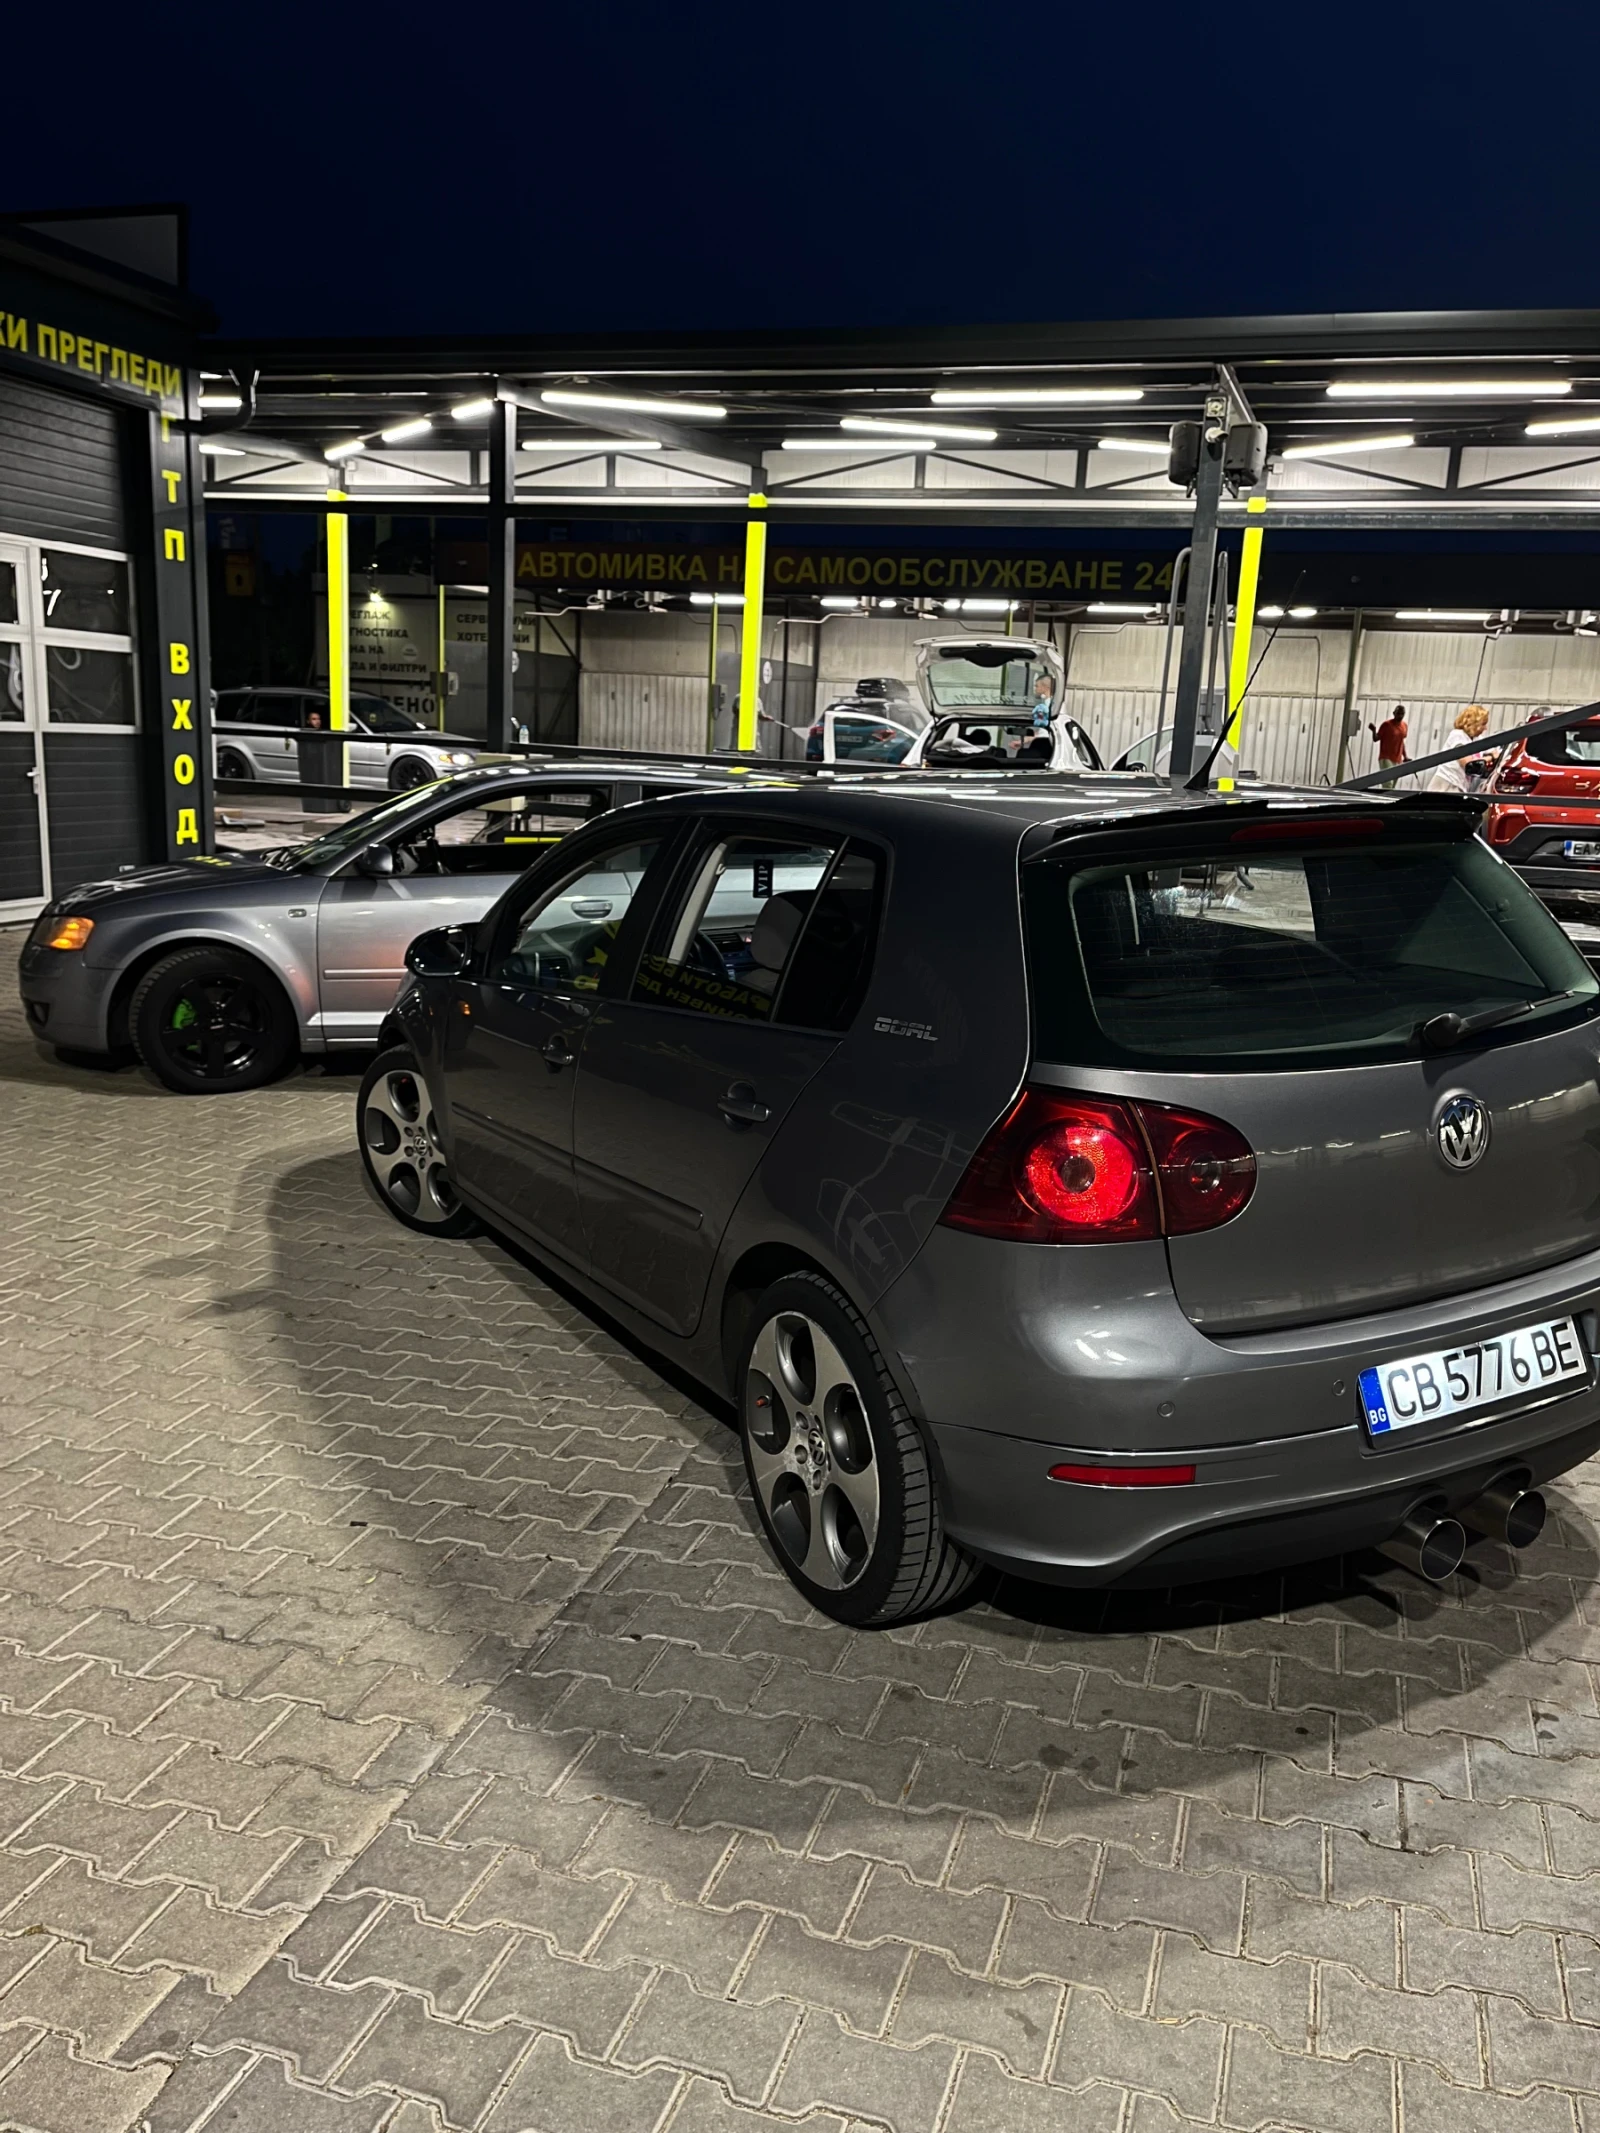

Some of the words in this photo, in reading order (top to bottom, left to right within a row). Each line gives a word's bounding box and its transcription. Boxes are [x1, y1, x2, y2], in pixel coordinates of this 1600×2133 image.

[0, 310, 28, 354] И
[37, 322, 183, 401] ПРЕГЛЕДИ
[517, 551, 708, 582] АВТОМИВКА
[717, 553, 746, 583] Н
[773, 554, 1123, 591] САМООБСЛУЖВАНЕ
[368, 645, 384, 655] НА
[379, 663, 427, 674] ФИЛТРИ
[169, 641, 200, 847] ВХОД
[757, 864, 769, 893] VIP
[1442, 1336, 1531, 1402] 5776
[1531, 1321, 1580, 1378] BE
[1369, 1408, 1388, 1425] BG
